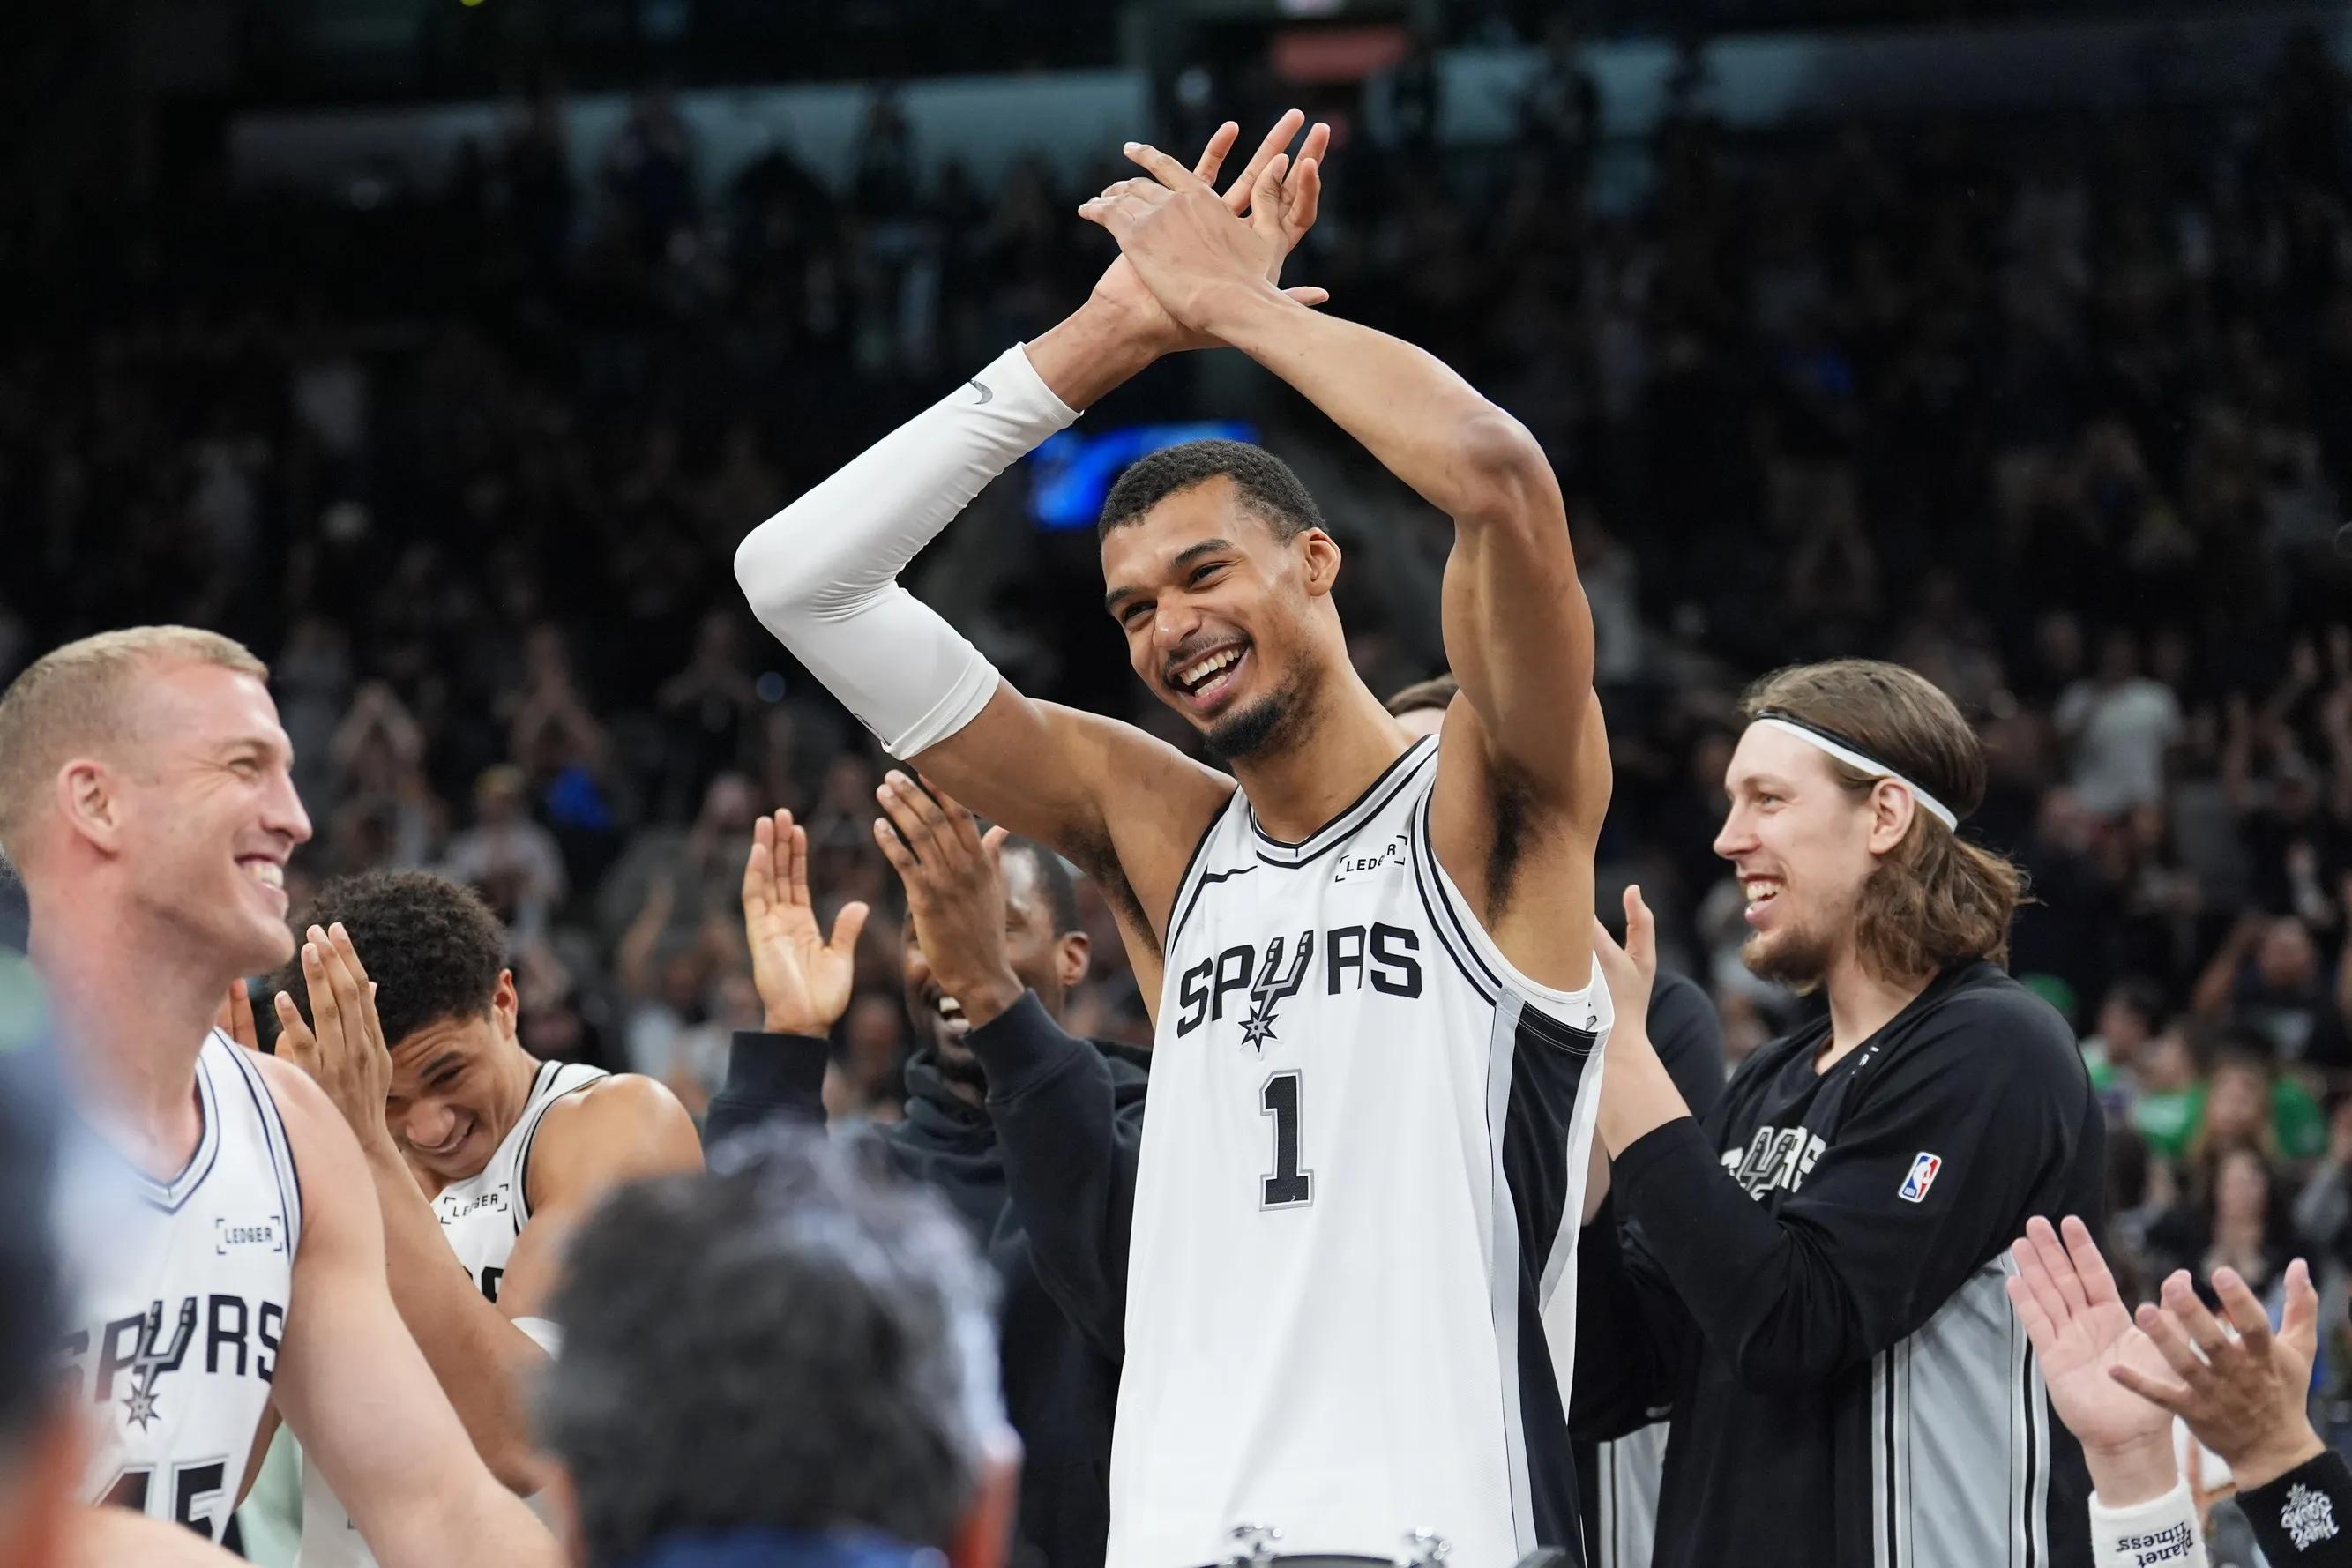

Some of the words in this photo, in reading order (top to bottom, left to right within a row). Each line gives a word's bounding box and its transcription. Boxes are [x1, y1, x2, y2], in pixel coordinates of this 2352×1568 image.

[1176, 922, 1422, 1053] SPURS
[1259, 1068, 1314, 1212] 1
[2115, 1521, 2187, 1554] fitness
[2136, 1528, 2194, 1568] planet
